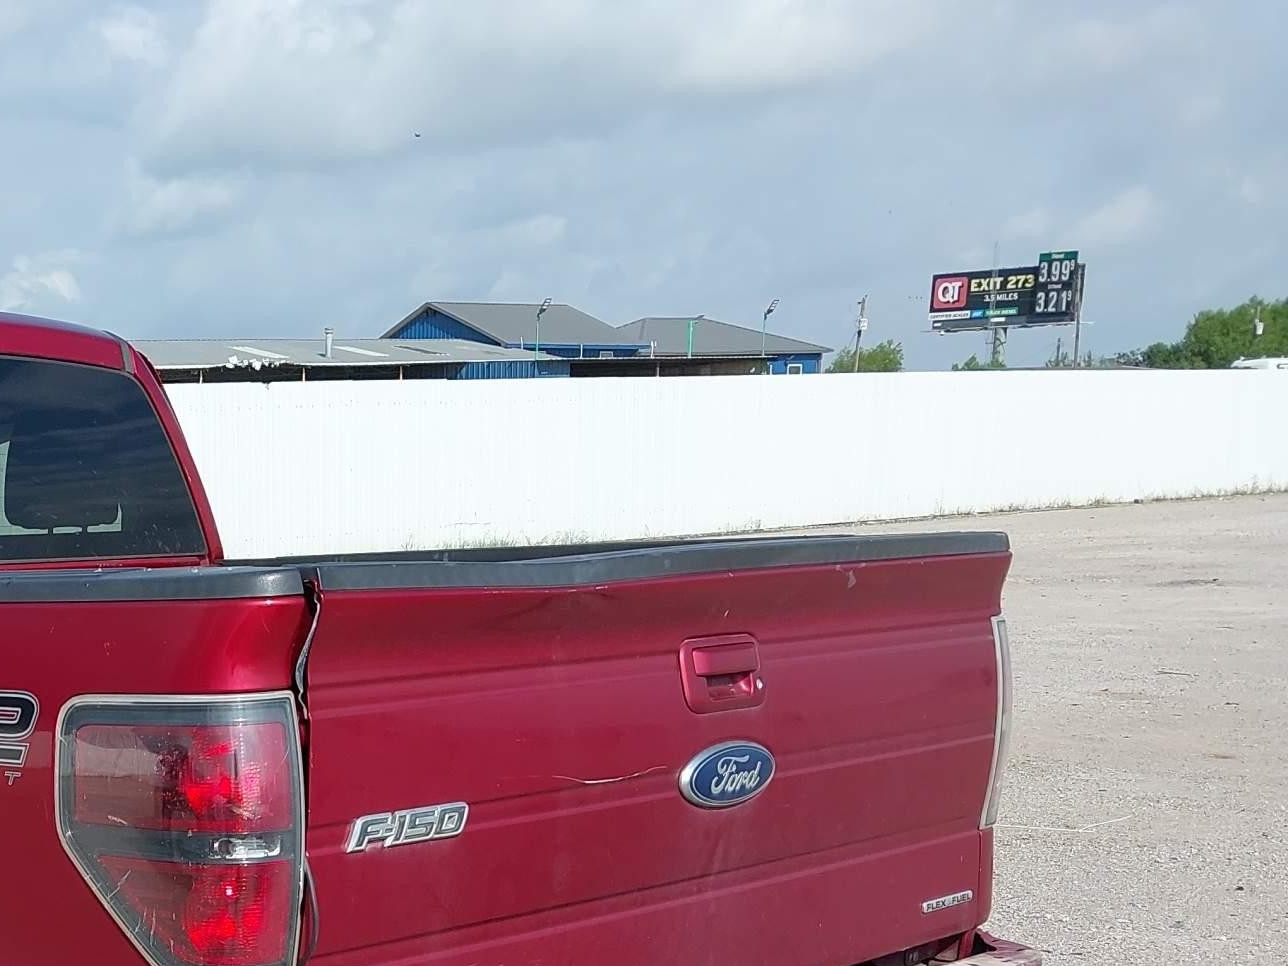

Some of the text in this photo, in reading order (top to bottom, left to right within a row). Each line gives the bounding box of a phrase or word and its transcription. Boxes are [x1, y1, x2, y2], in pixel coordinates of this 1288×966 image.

[937, 281, 963, 304] QT
[970, 274, 1035, 292] EXIT 273
[996, 293, 1018, 301] MILES
[711, 755, 762, 794] Ford
[346, 801, 469, 853] F-150
[926, 893, 970, 911] FLEX FUEL
